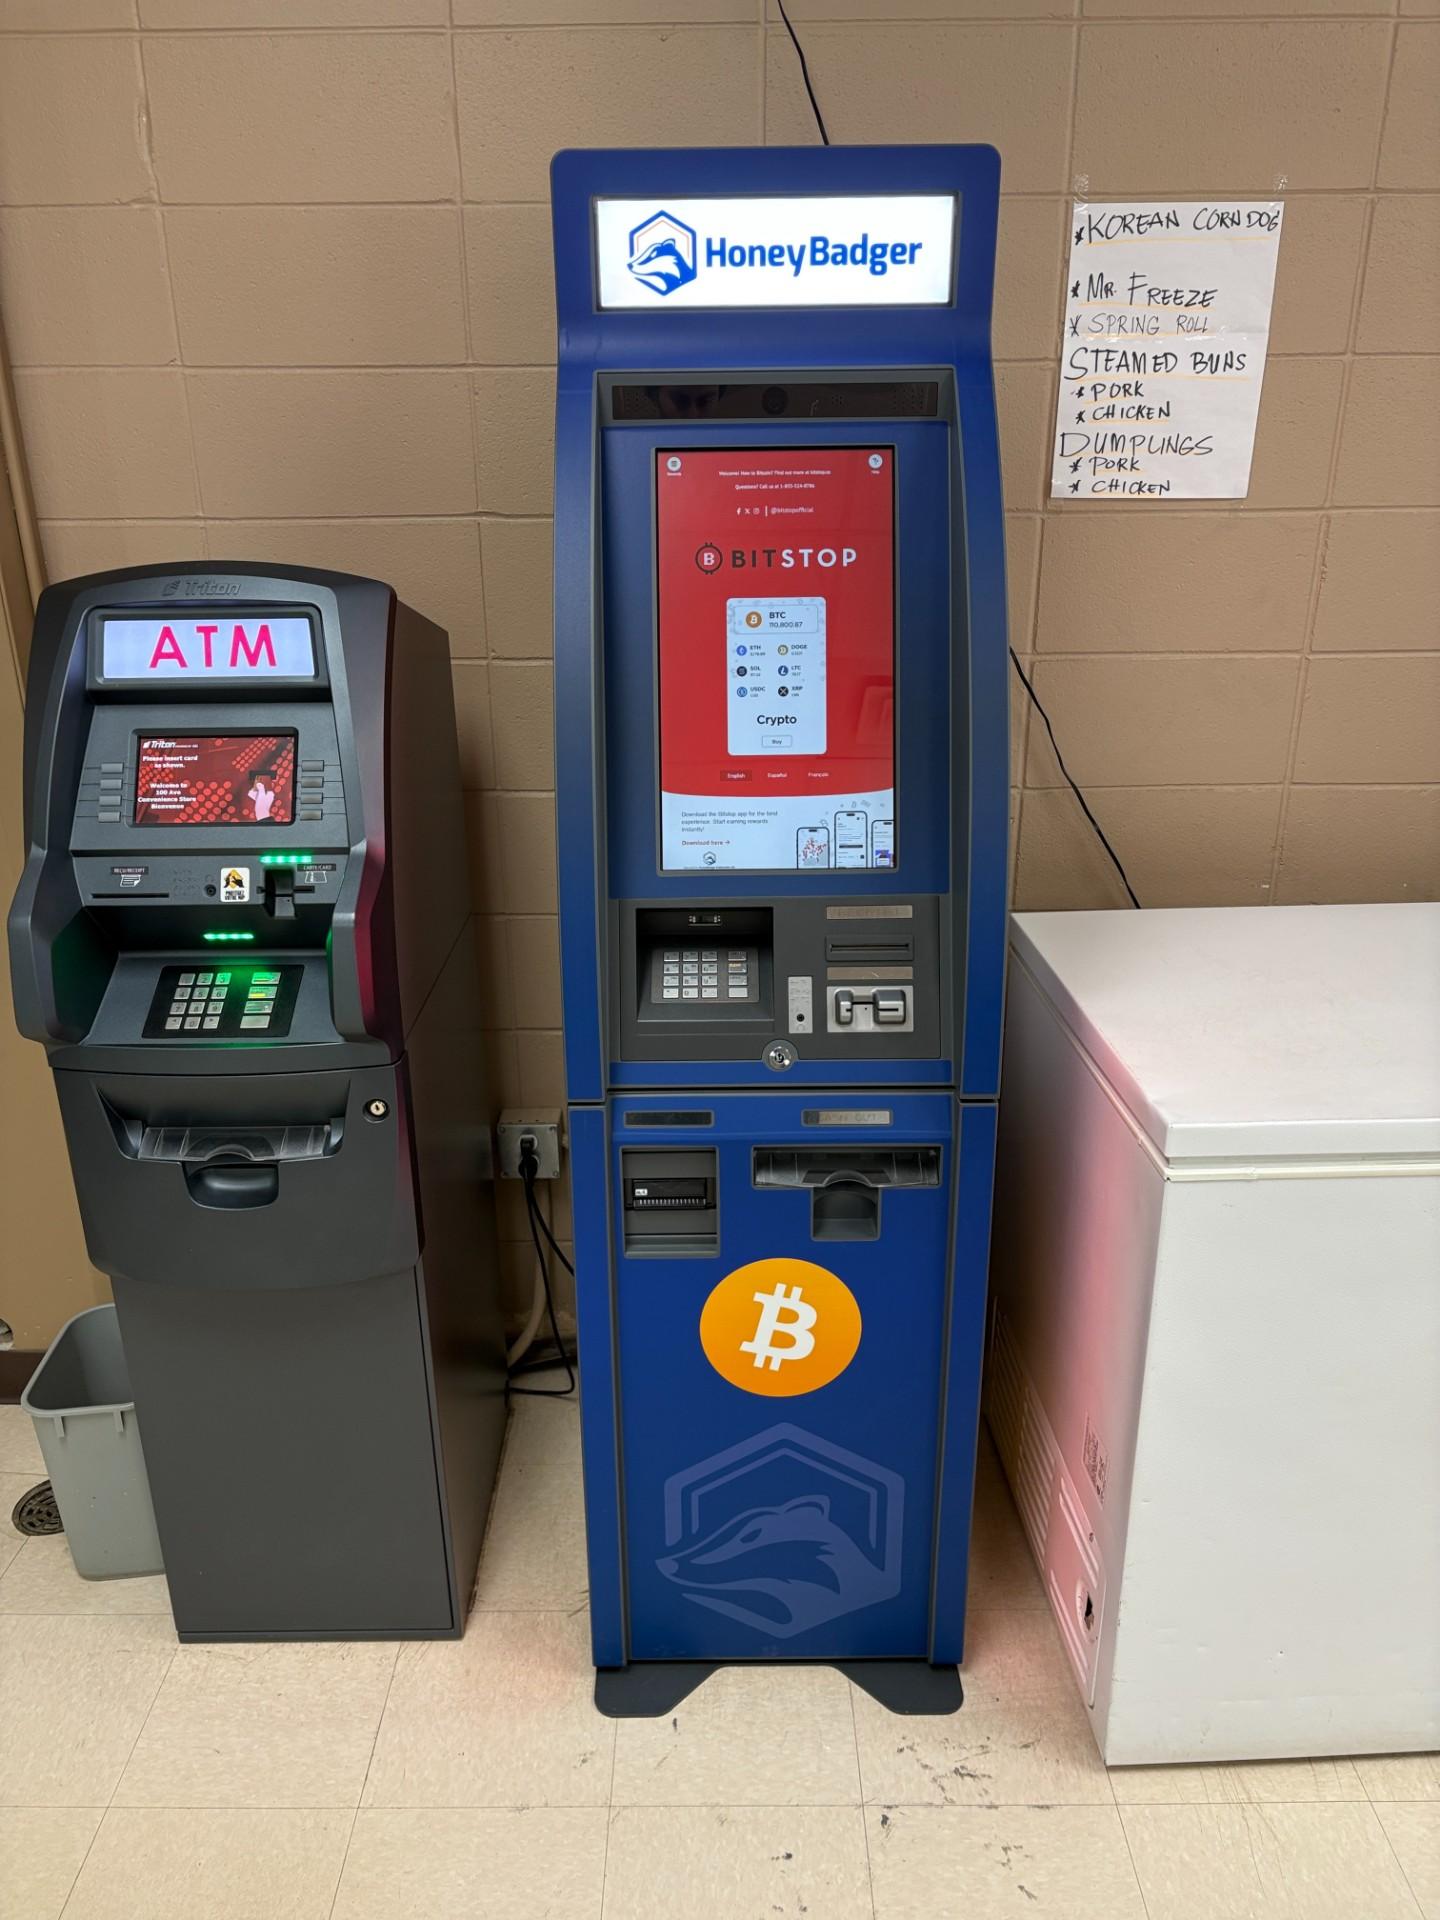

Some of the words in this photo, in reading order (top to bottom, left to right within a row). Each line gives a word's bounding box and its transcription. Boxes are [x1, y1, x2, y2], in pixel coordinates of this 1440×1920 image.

[1088, 210, 1179, 243] KOREAN
[1193, 208, 1241, 231] CORN
[1246, 210, 1279, 231] DOG
[706, 233, 922, 277] HoneyBadger
[1128, 271, 1218, 307] FREEZE
[1088, 313, 1159, 335] SPRING
[1177, 314, 1208, 333] ROLL
[1064, 347, 1177, 380] STEAMED
[1191, 351, 1247, 374] BUNS
[1091, 381, 1144, 402] PORK
[1092, 401, 1170, 421] CHICKEN
[1060, 432, 1213, 457] DUMPLINGS
[1090, 457, 1140, 475] PORK
[1091, 480, 1170, 495] CHICKEN
[732, 548, 857, 568] BITSTOP
[185, 580, 241, 595] Triton
[769, 611, 786, 619] BTC
[150, 624, 277, 669] ATM
[757, 714, 797, 726] Crypto
[151, 740, 176, 749] Triton
